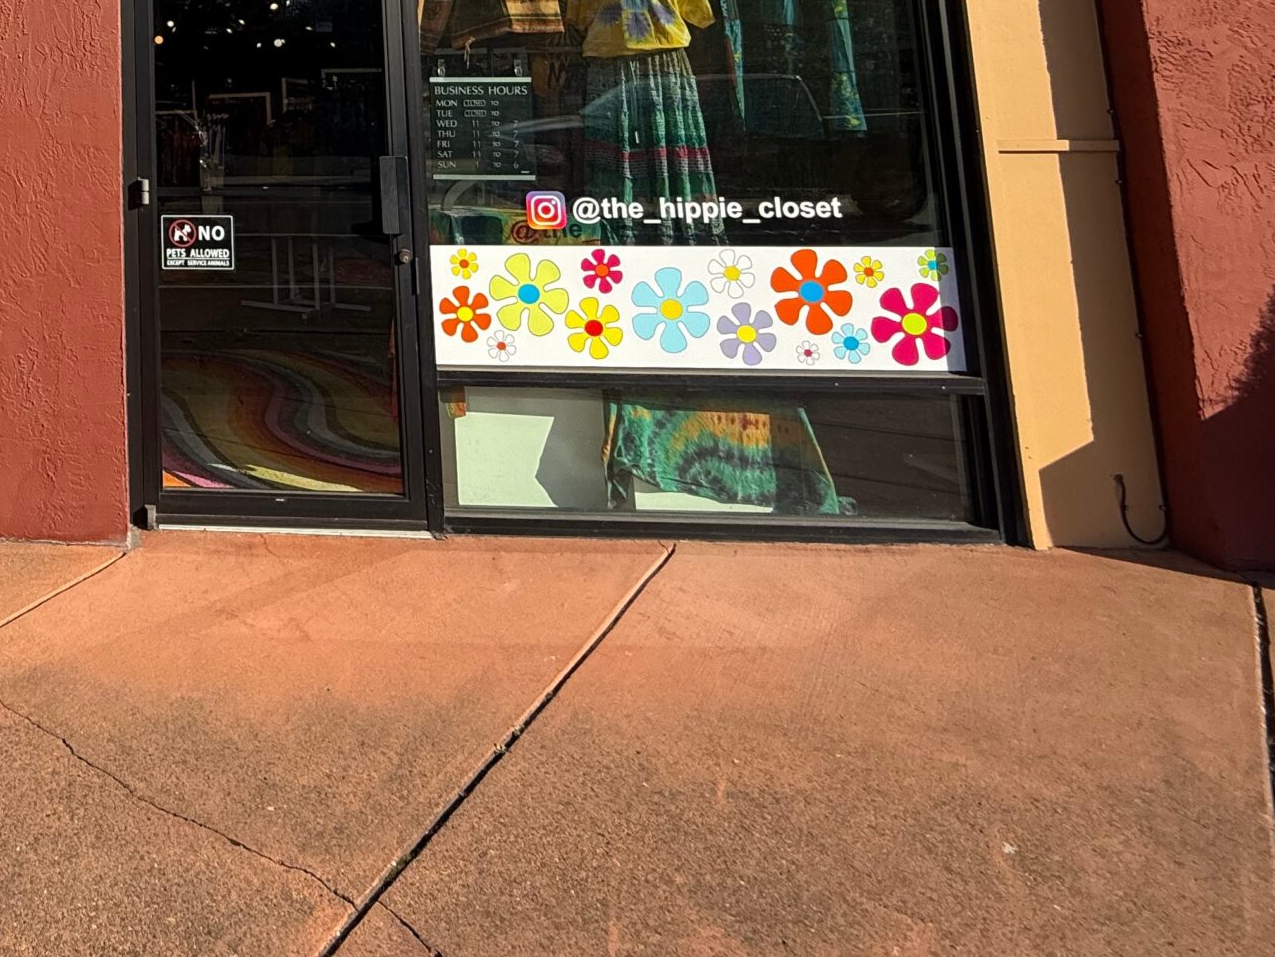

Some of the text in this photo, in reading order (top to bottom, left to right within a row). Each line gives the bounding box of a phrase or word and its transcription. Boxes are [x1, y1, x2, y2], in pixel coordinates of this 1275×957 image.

[434, 86, 528, 95] BUSINESS HOURS
[436, 99, 458, 107] MON
[436, 120, 458, 128] WED
[437, 130, 456, 138] THU
[437, 140, 451, 148] FRI
[437, 150, 453, 158] SAT
[437, 160, 457, 169] SUN
[573, 196, 842, 225] @the_hippie_closet
[198, 225, 225, 241] NO
[166, 248, 230, 258] PETS ALLOWED
